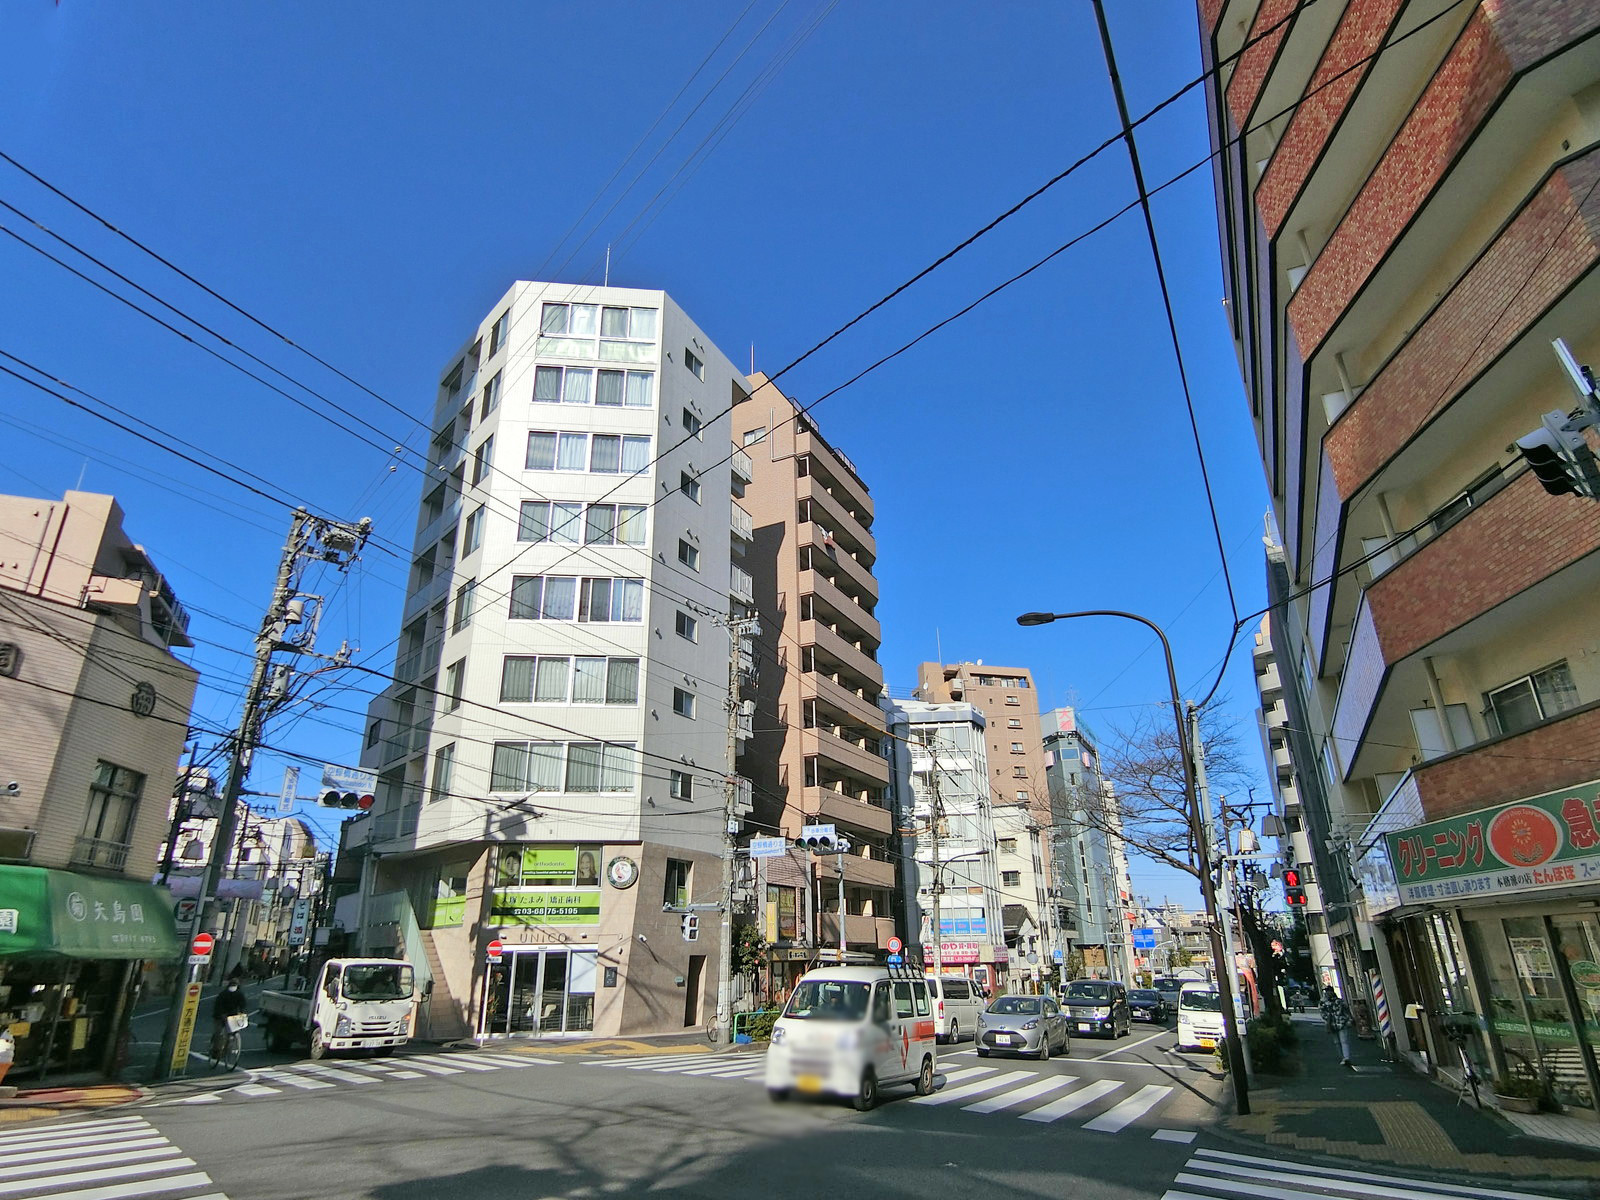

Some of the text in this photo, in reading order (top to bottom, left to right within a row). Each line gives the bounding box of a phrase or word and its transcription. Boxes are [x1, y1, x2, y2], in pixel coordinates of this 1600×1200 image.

[1397, 818, 1485, 878] クリーニング
[1560, 791, 1600, 851] 急
